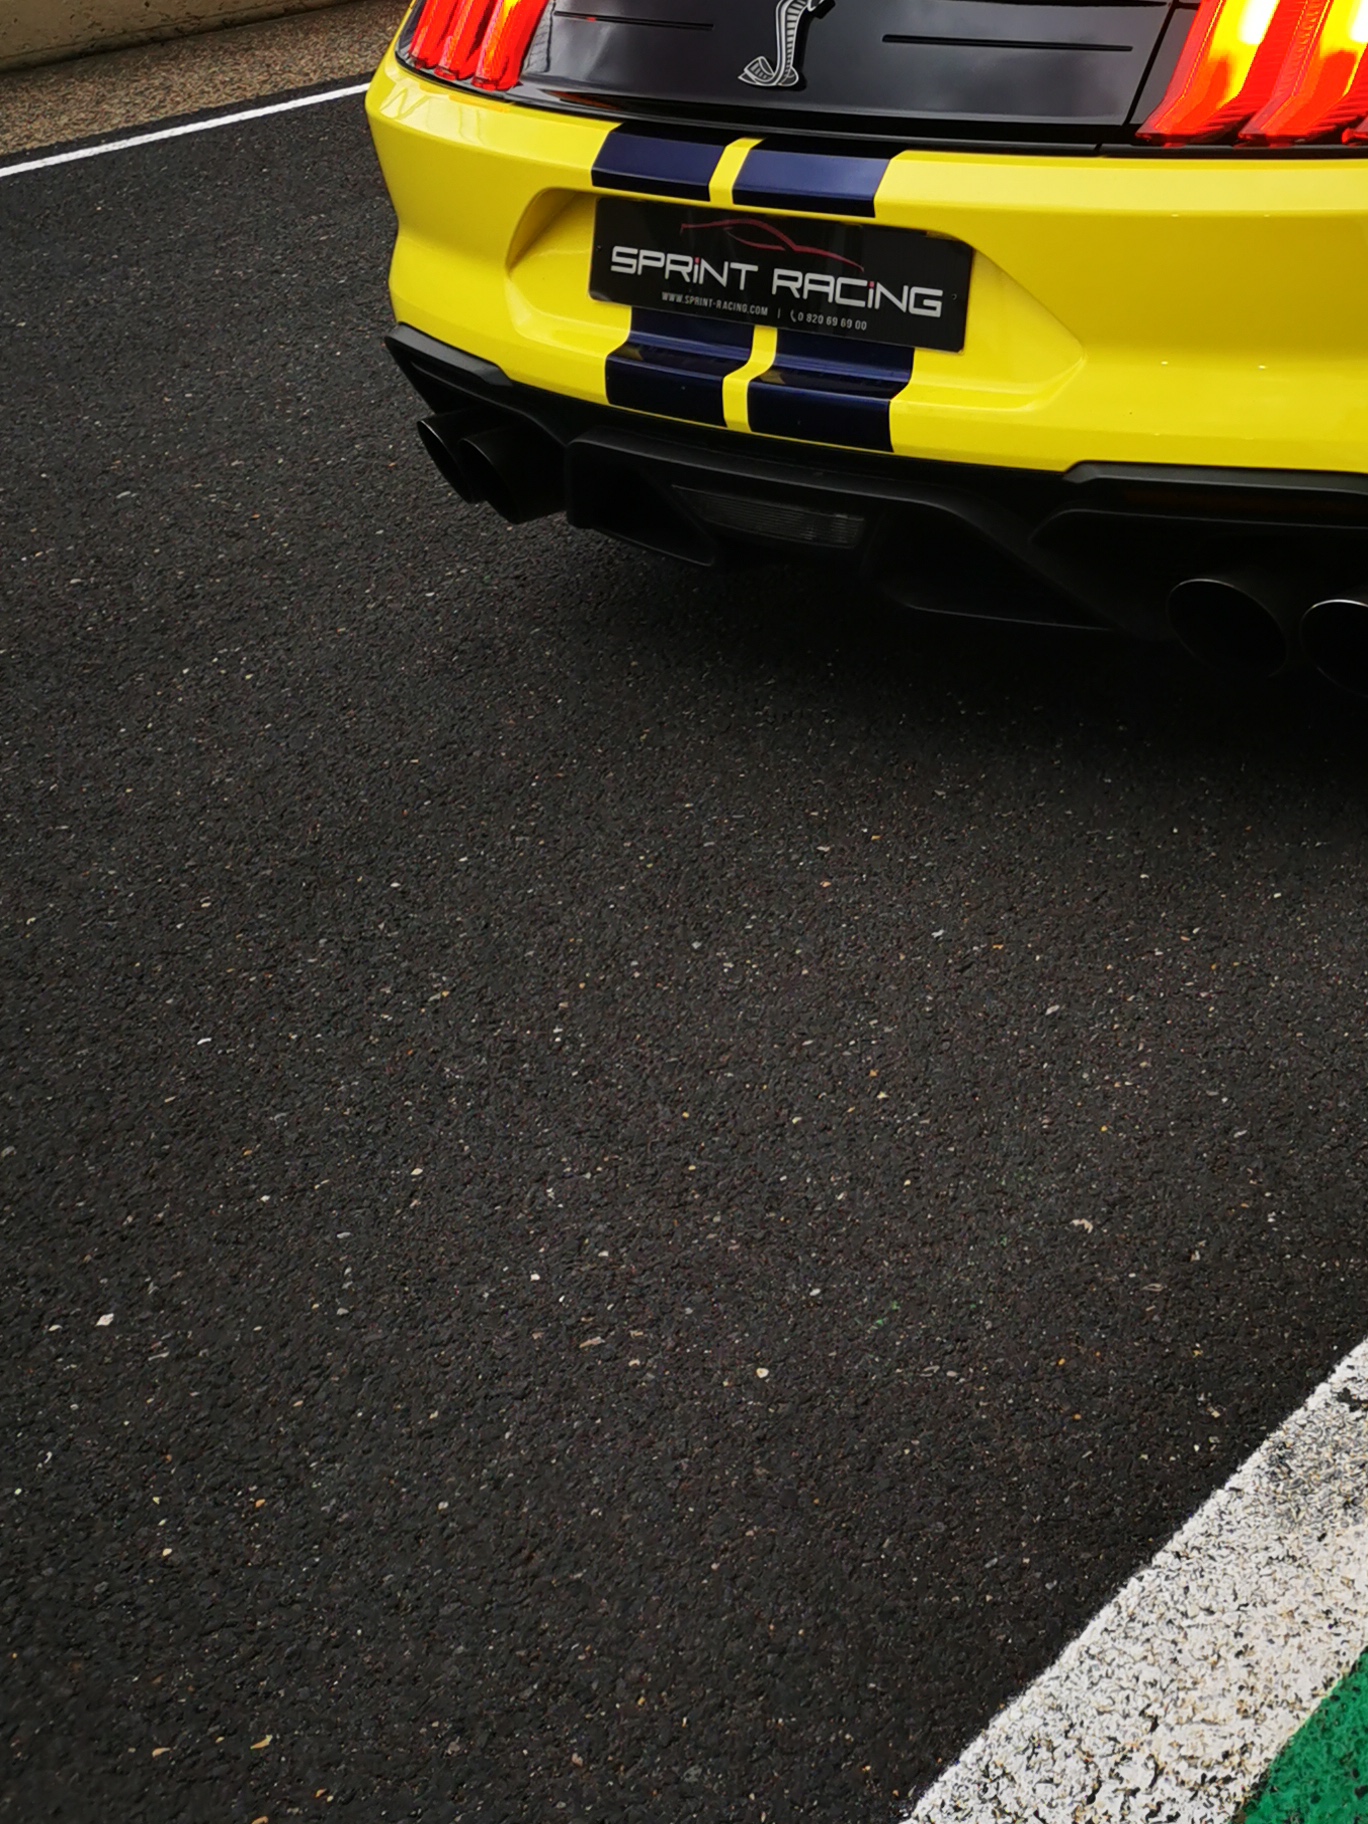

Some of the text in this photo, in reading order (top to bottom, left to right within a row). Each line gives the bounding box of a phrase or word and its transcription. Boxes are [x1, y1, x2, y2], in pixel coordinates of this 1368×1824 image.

[661, 291, 768, 316] WWW.SPRINT-RACING.COM
[806, 313, 823, 325] 820
[826, 315, 838, 327] 69
[855, 319, 867, 331] 00
